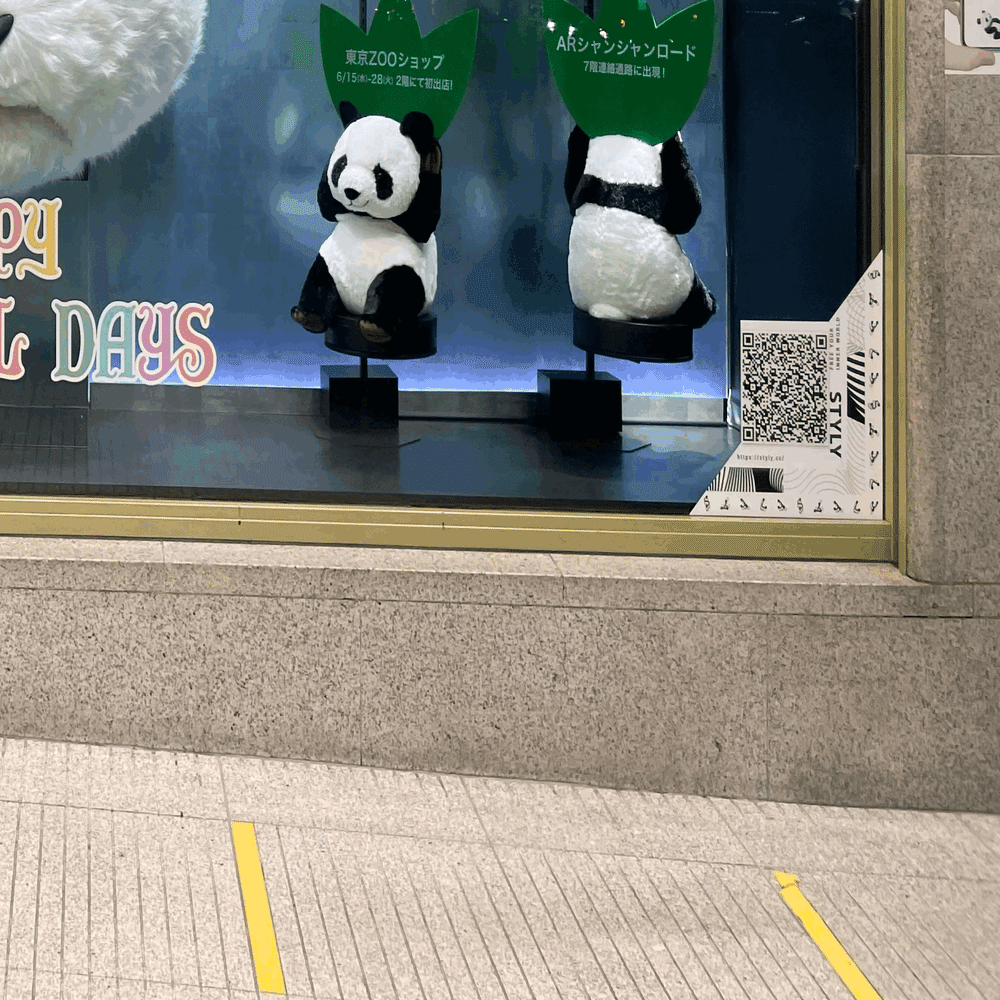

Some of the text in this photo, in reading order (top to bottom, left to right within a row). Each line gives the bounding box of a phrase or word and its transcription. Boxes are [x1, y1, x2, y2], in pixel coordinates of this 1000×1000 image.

[345, 49, 445, 70] 東京ZOOショップ
[556, 35, 696, 62] ARシャンシャンロード
[50, 299, 218, 387] DAYS
[829, 391, 842, 459] STYLY
